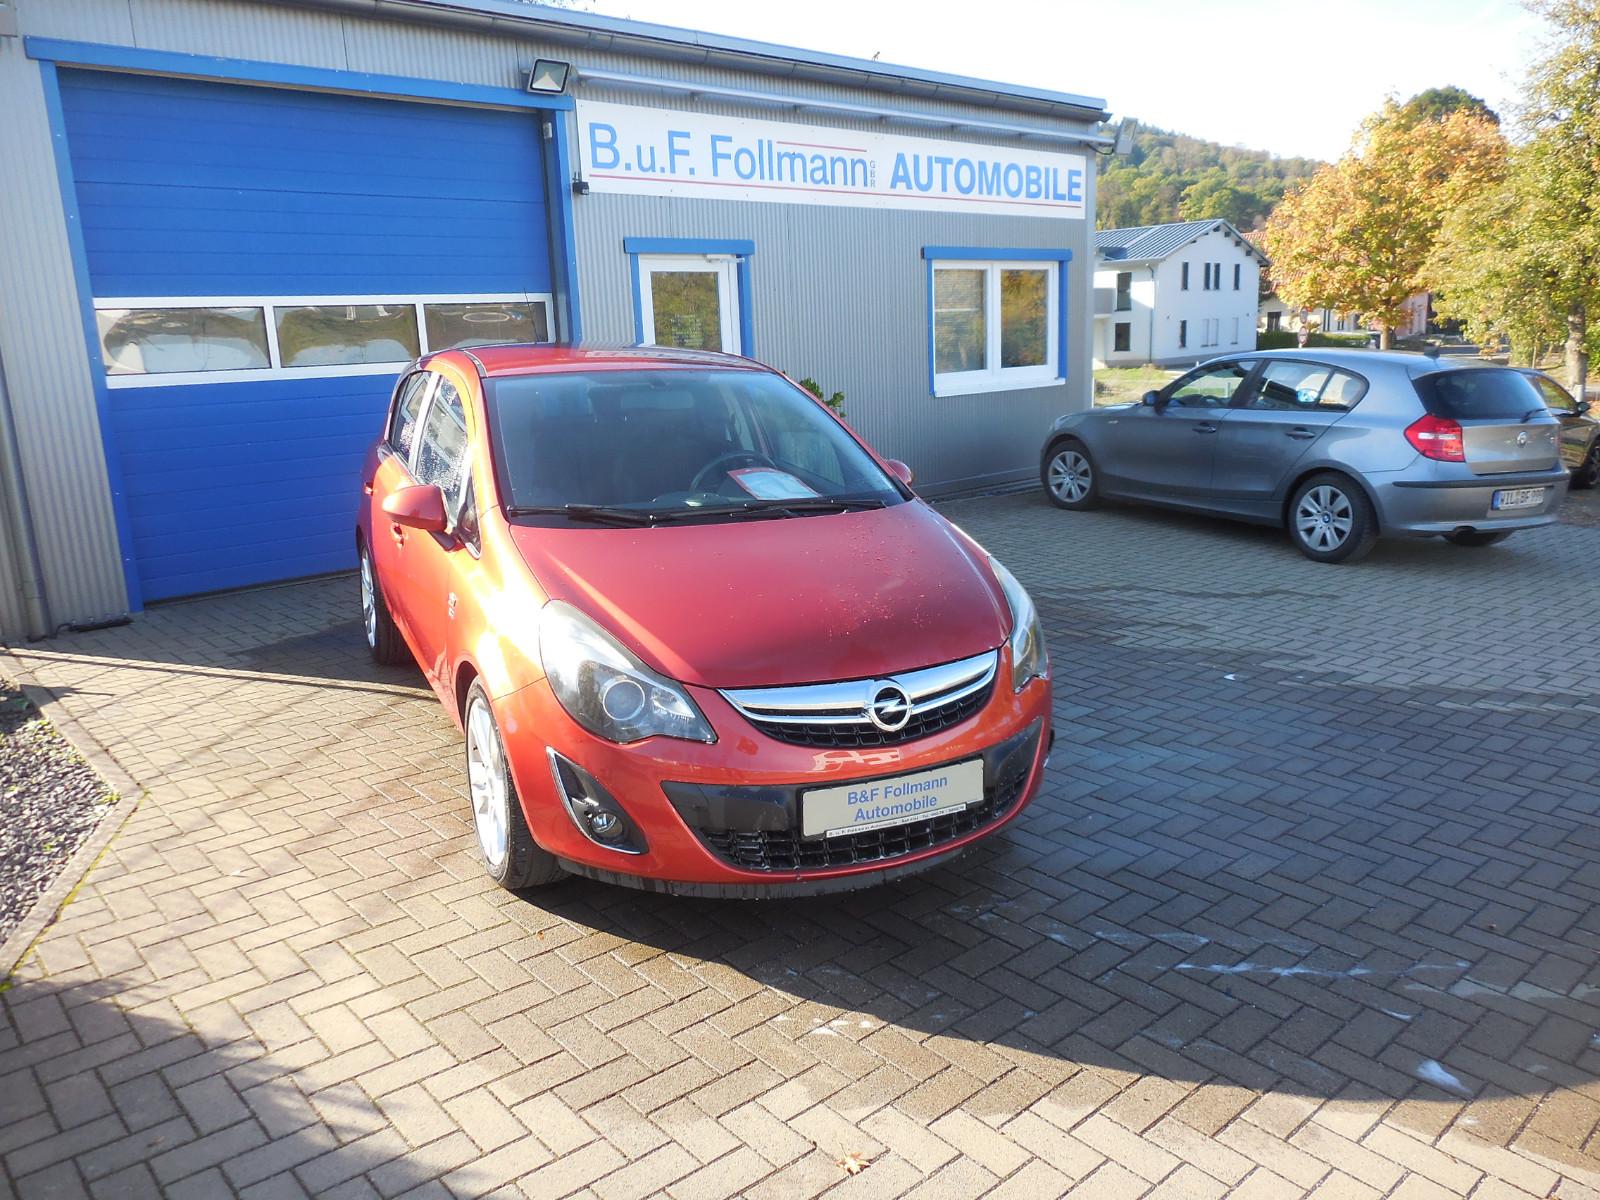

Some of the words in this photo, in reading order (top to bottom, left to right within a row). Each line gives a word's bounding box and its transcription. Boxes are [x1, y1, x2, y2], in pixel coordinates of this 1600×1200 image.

[711, 134, 868, 187] Follmann
[889, 152, 1082, 202] AUTOMOBILE
[848, 783, 879, 805] B&F
[884, 777, 947, 799] Follmann
[854, 795, 937, 822] Automobile
